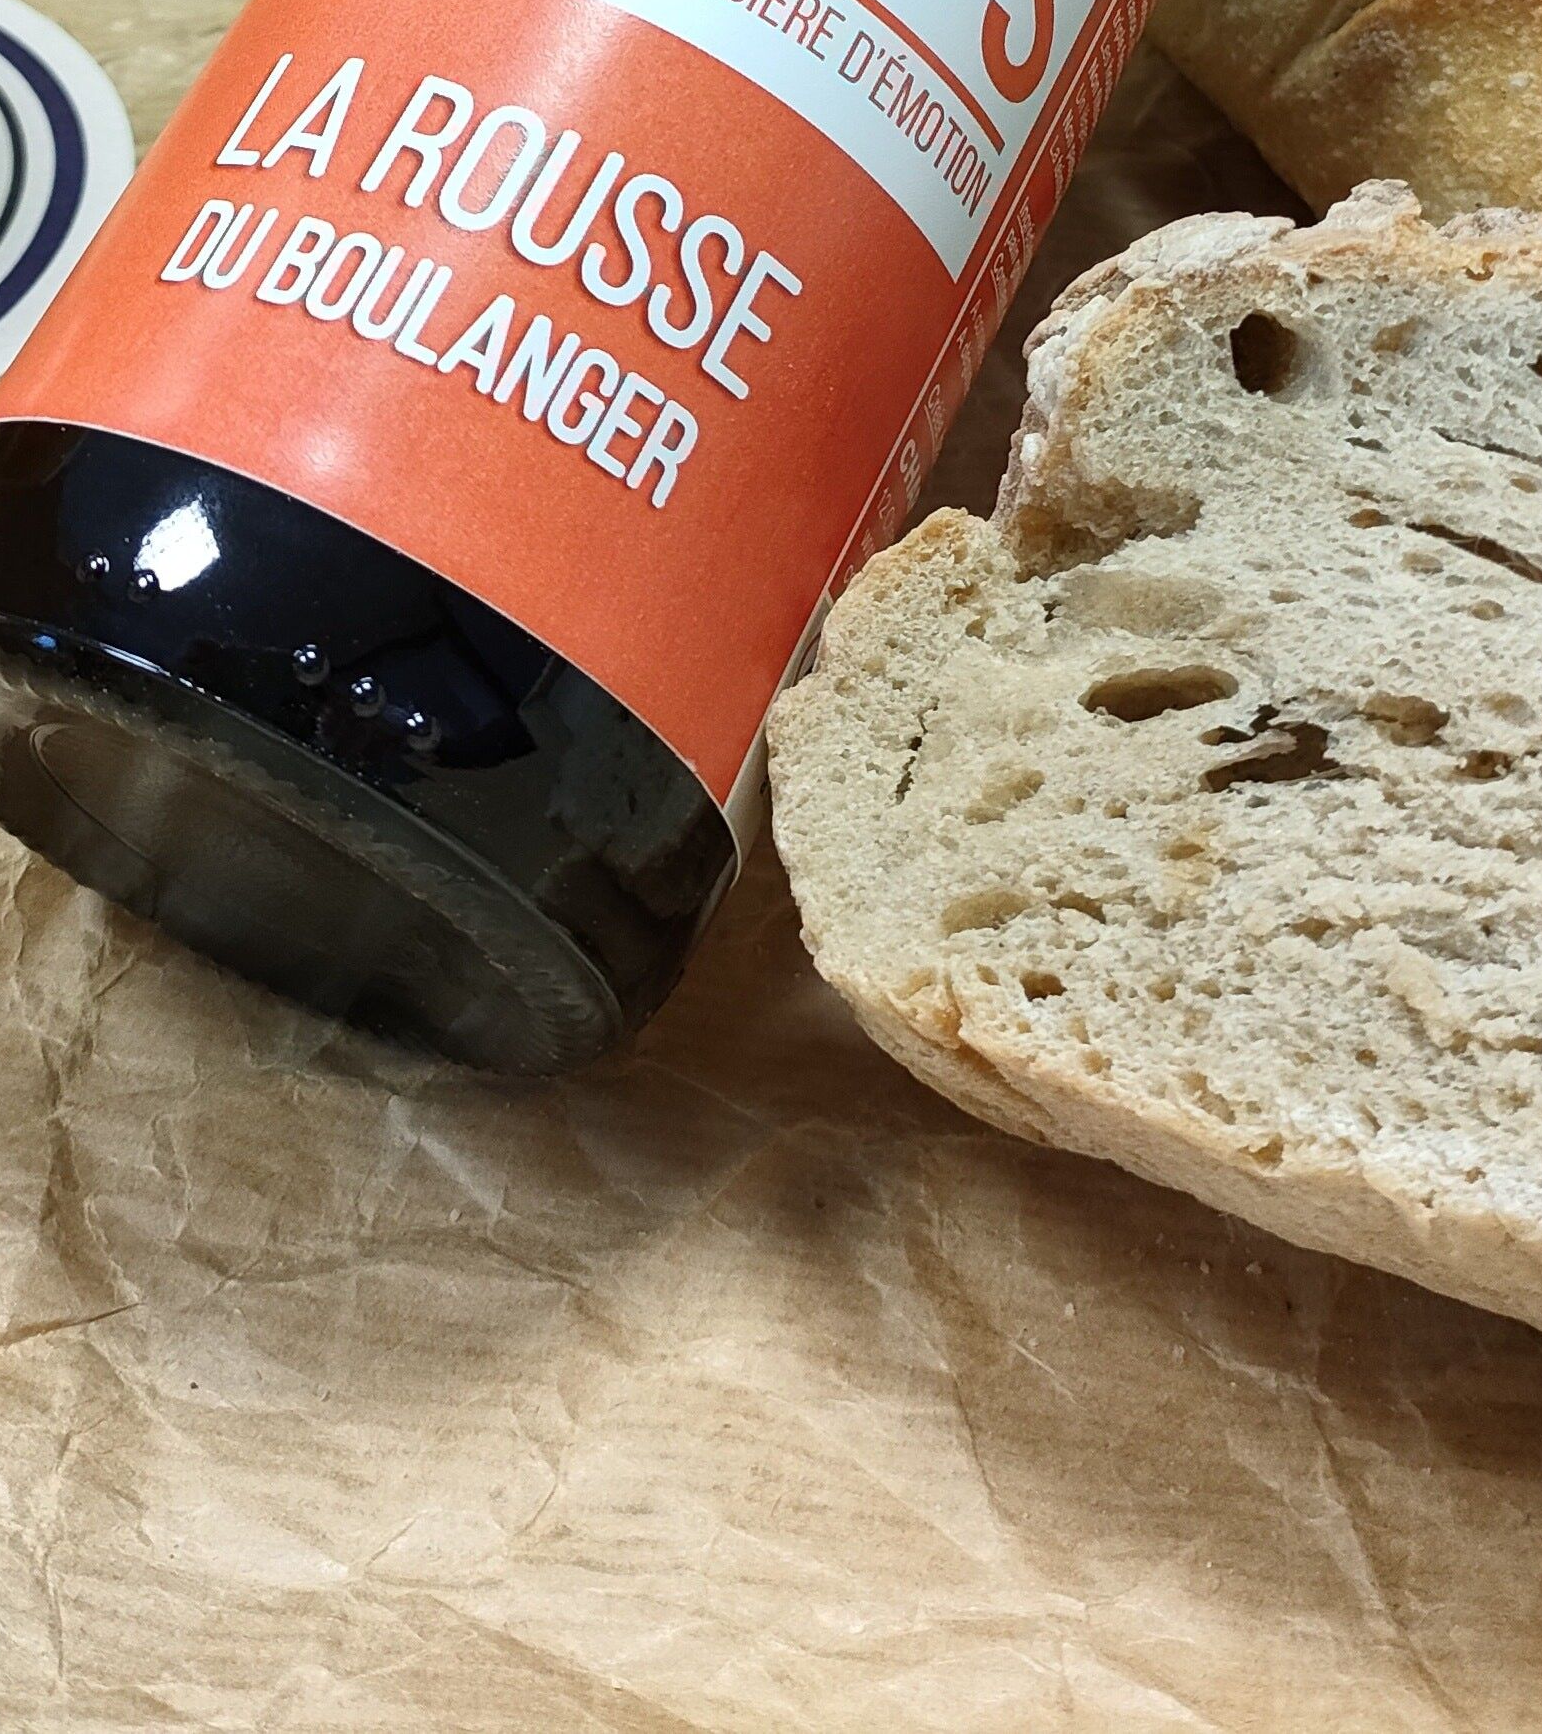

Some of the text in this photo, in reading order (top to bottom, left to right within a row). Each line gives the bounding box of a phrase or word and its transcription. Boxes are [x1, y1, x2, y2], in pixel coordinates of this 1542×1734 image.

[215, 52, 366, 178] LA
[359, 74, 803, 400] ROUSSE
[847, 33, 994, 219] D'ÉMOTION
[160, 198, 279, 289] DU
[255, 215, 700, 510] BOULANGER
